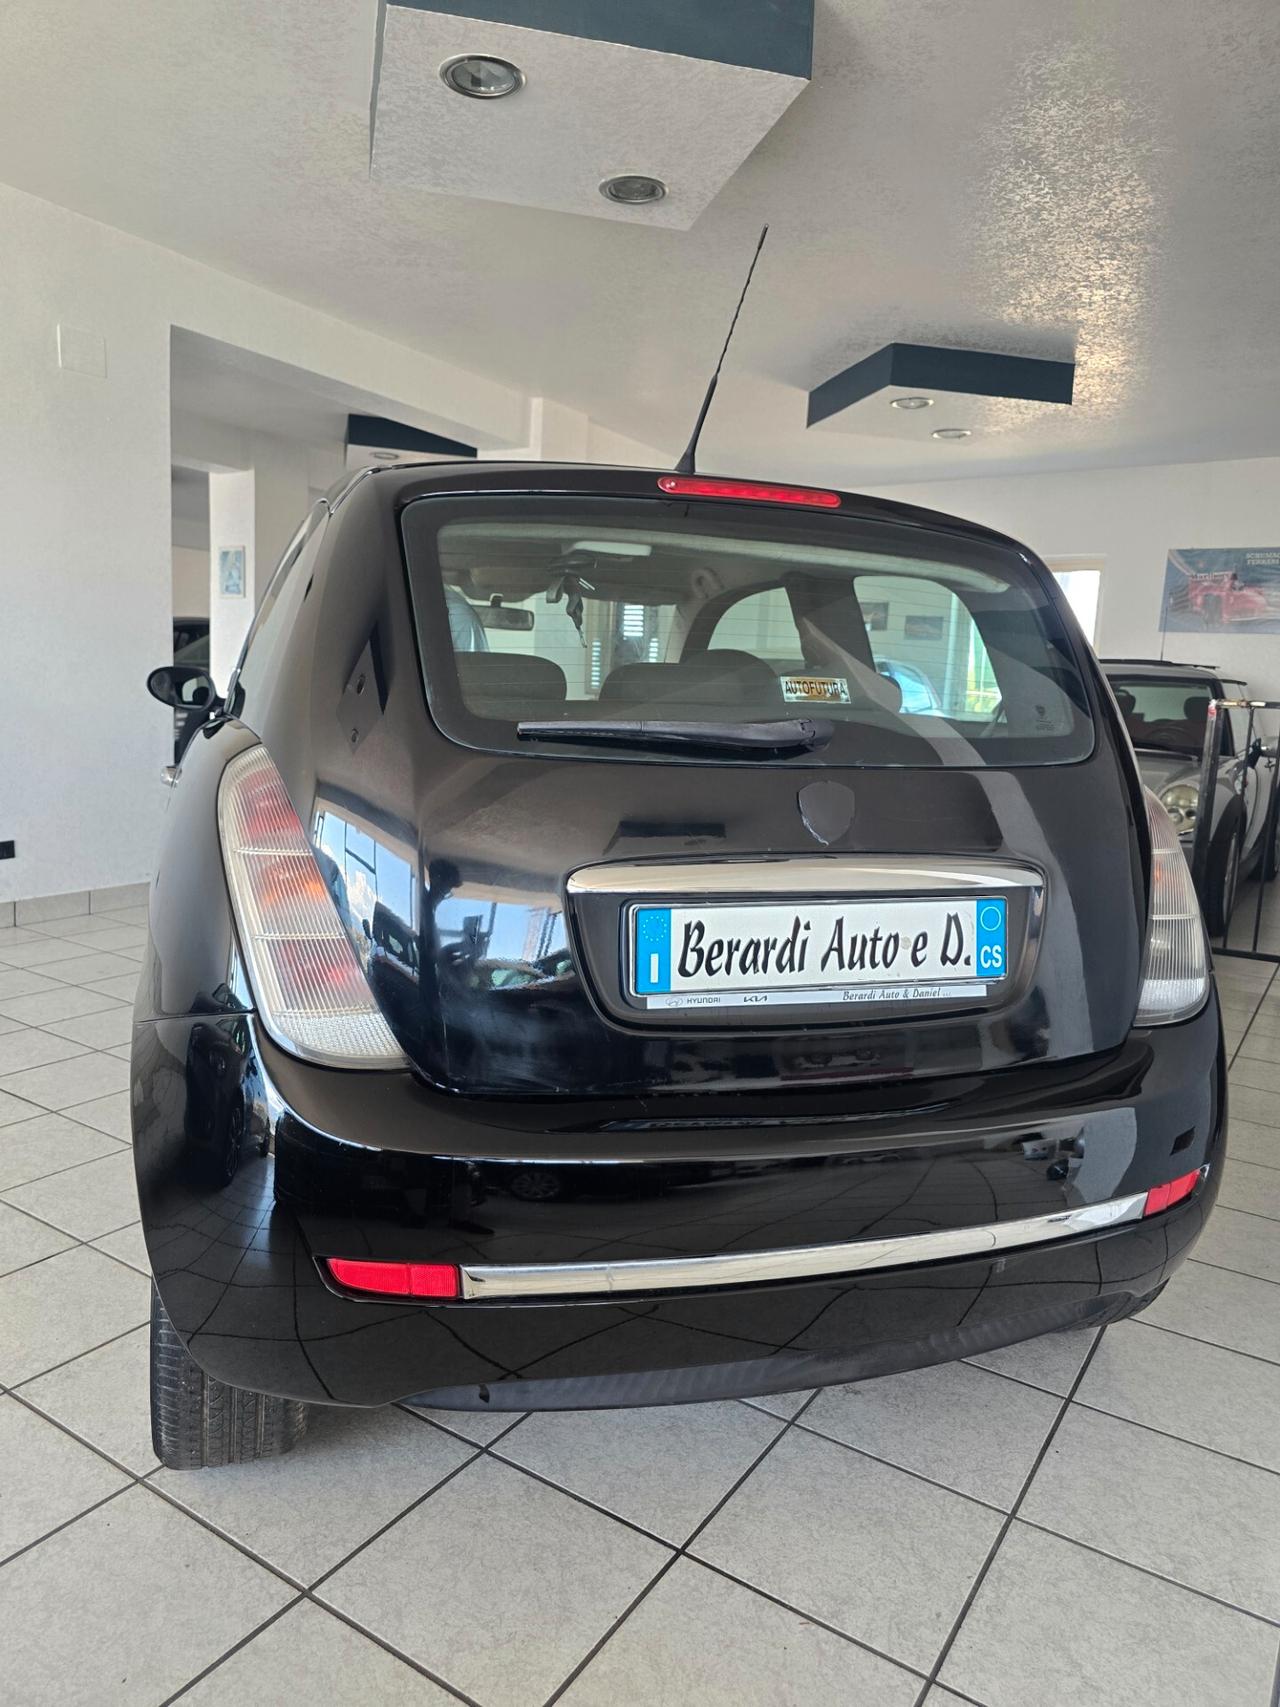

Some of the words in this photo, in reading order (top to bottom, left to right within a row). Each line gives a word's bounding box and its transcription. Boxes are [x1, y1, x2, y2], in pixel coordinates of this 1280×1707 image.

[785, 681, 846, 695] AUTOFUTURA
[678, 915, 811, 978] Berardi
[821, 916, 900, 972] Auto
[911, 930, 929, 966] e
[941, 912, 971, 967] D.
[980, 945, 1002, 969] CS
[686, 997, 721, 1005] HYUNDAI
[743, 995, 768, 1003] KIA
[843, 990, 877, 1001] Berardi
[879, 989, 900, 1000] Auto
[902, 988, 909, 998] &
[912, 988, 941, 998] Daniel
